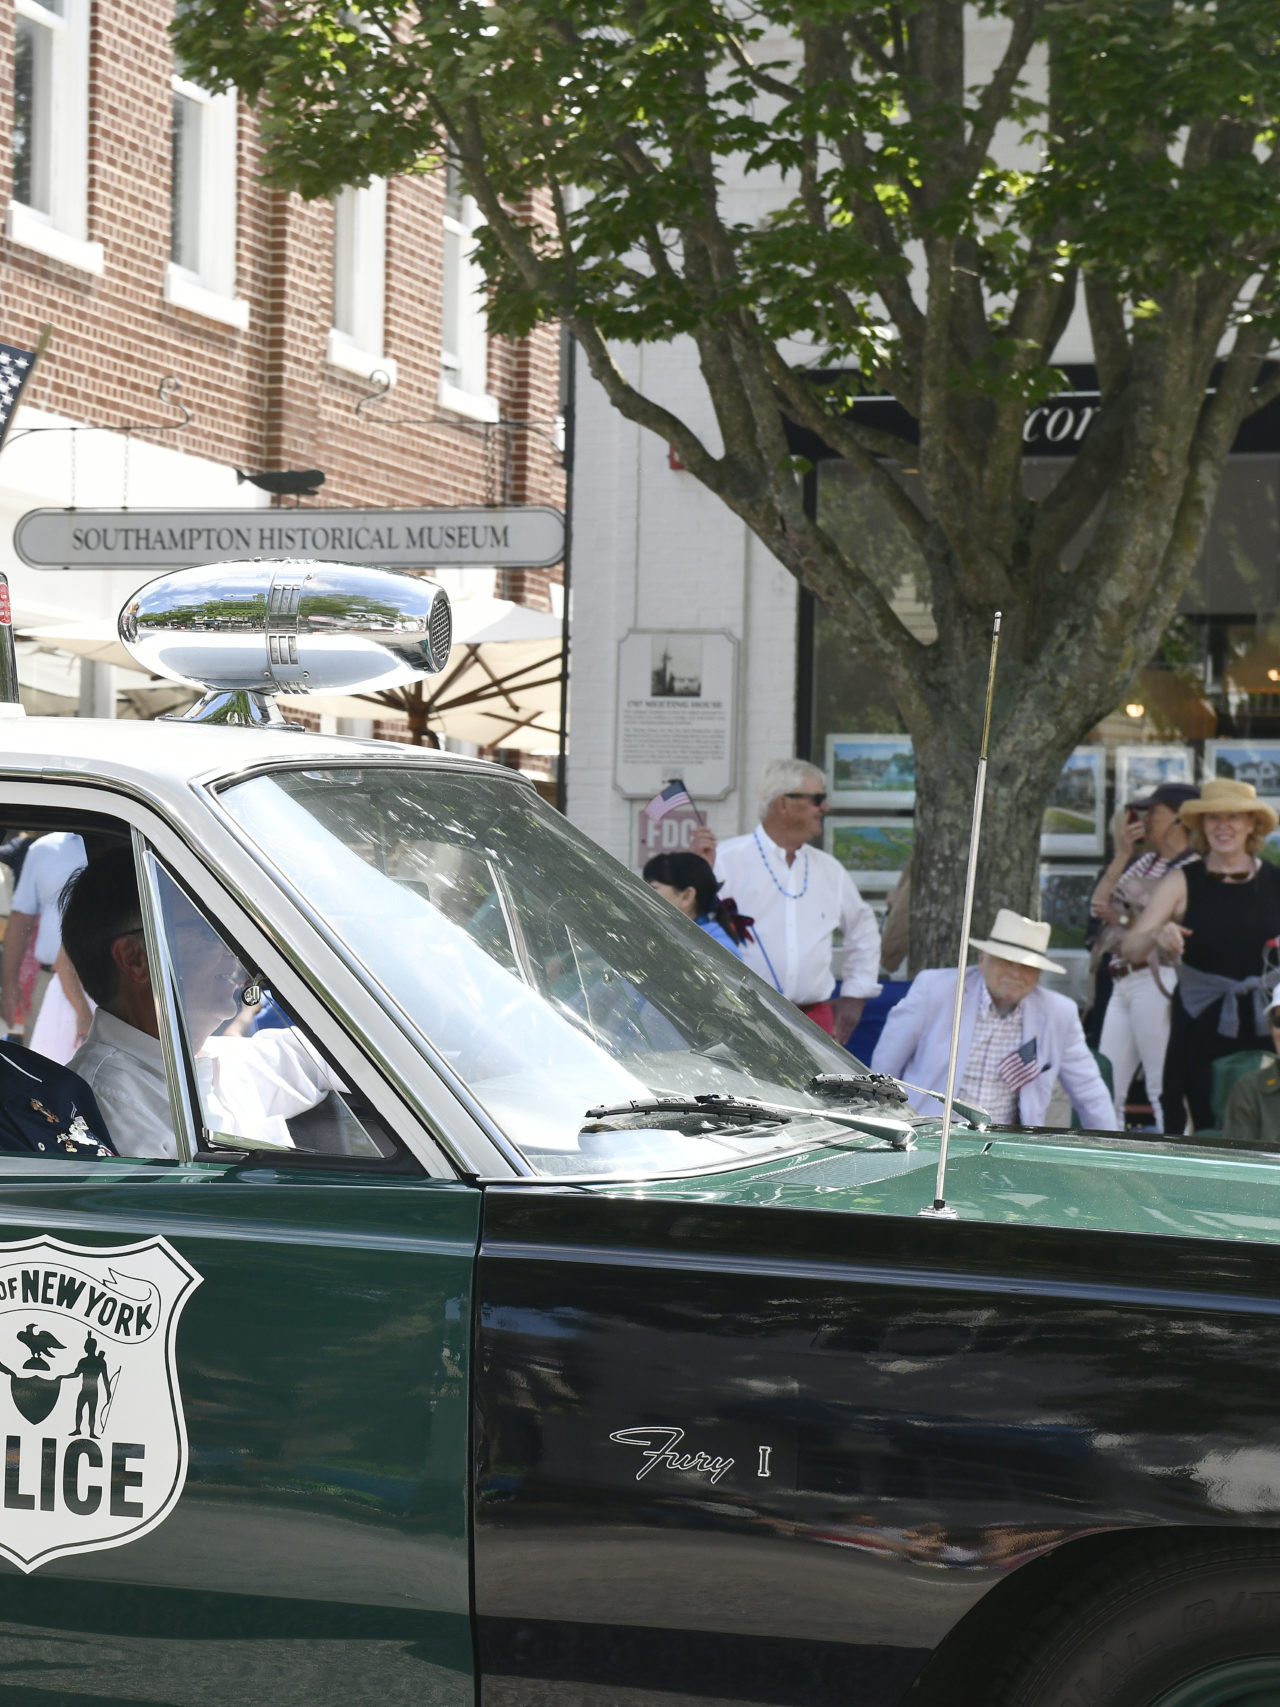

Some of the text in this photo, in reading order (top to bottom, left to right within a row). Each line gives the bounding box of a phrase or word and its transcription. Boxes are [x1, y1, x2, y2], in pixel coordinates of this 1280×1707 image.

[72, 525, 510, 551] SOUTHAMPTON HISTORICAL MUSEUM
[21, 1269, 87, 1310] NEW
[83, 1285, 152, 1337] YORK
[609, 1426, 735, 1485] Fury
